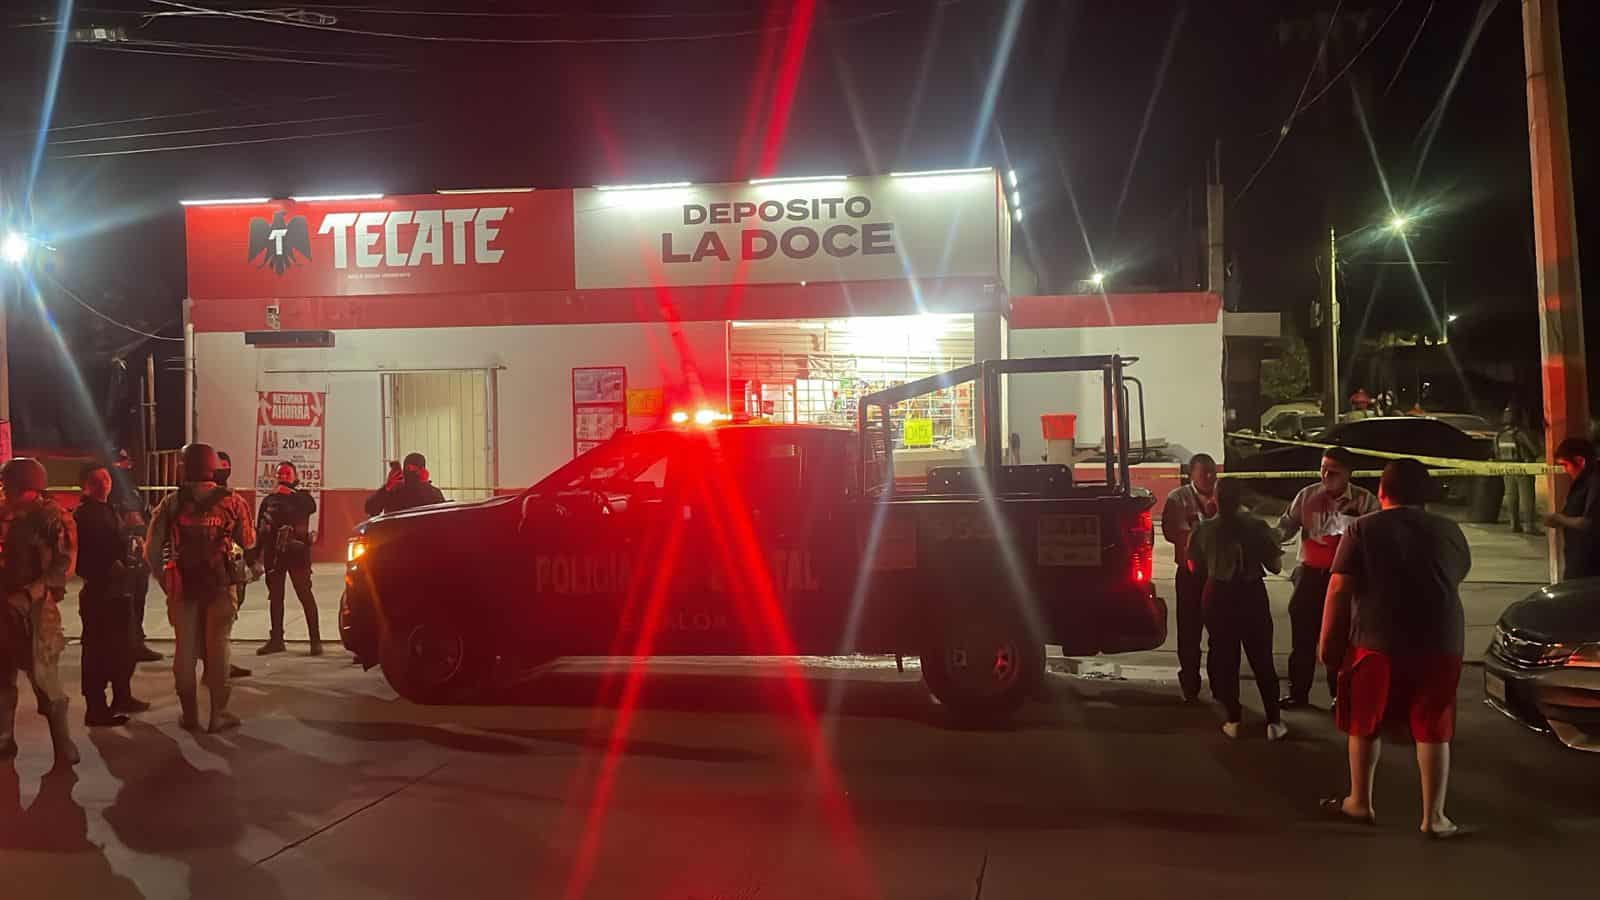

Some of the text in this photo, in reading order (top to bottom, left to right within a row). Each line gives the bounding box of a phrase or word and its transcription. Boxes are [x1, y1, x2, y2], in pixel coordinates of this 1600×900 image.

[683, 195, 872, 225] DEPOSITO
[317, 206, 508, 269] TECATE
[661, 222, 896, 263] LA DOCE
